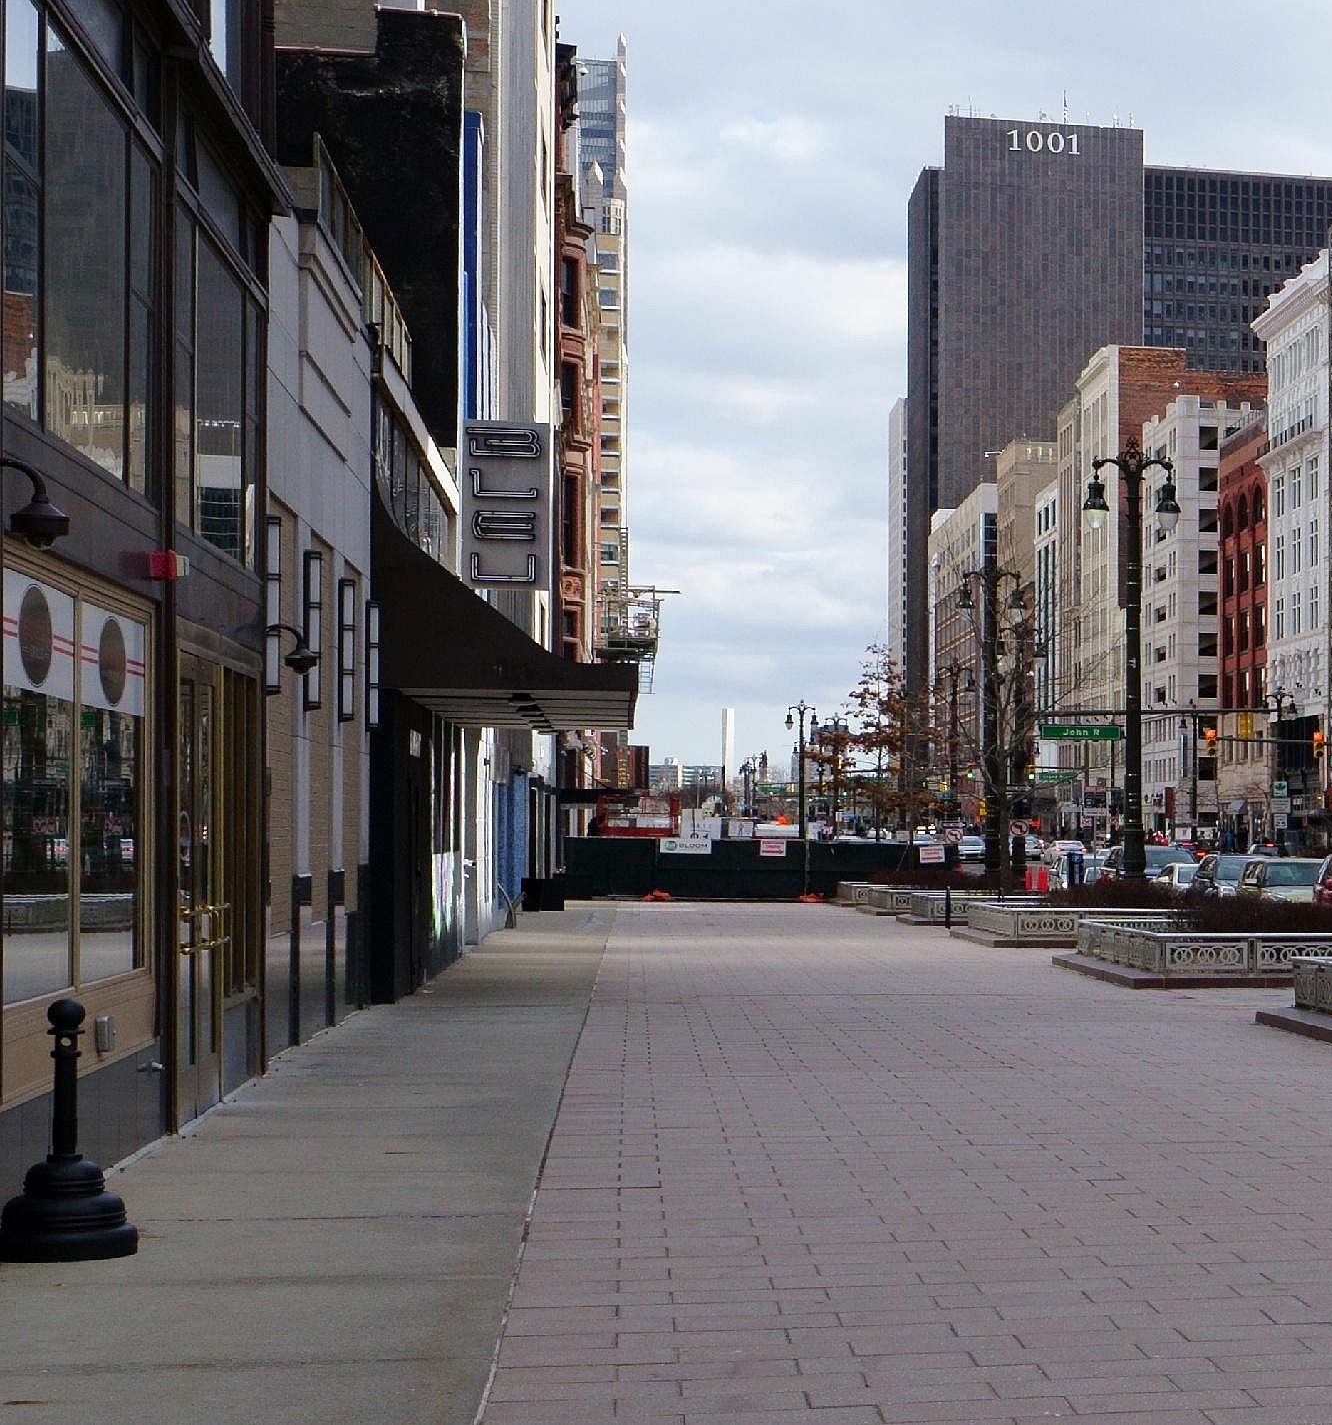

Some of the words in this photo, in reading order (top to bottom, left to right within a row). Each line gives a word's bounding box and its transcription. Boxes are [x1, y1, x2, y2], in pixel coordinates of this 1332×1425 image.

[1006, 129, 1081, 155] 1001
[466, 427, 541, 583] BLEU
[1063, 728, 1089, 736] John
